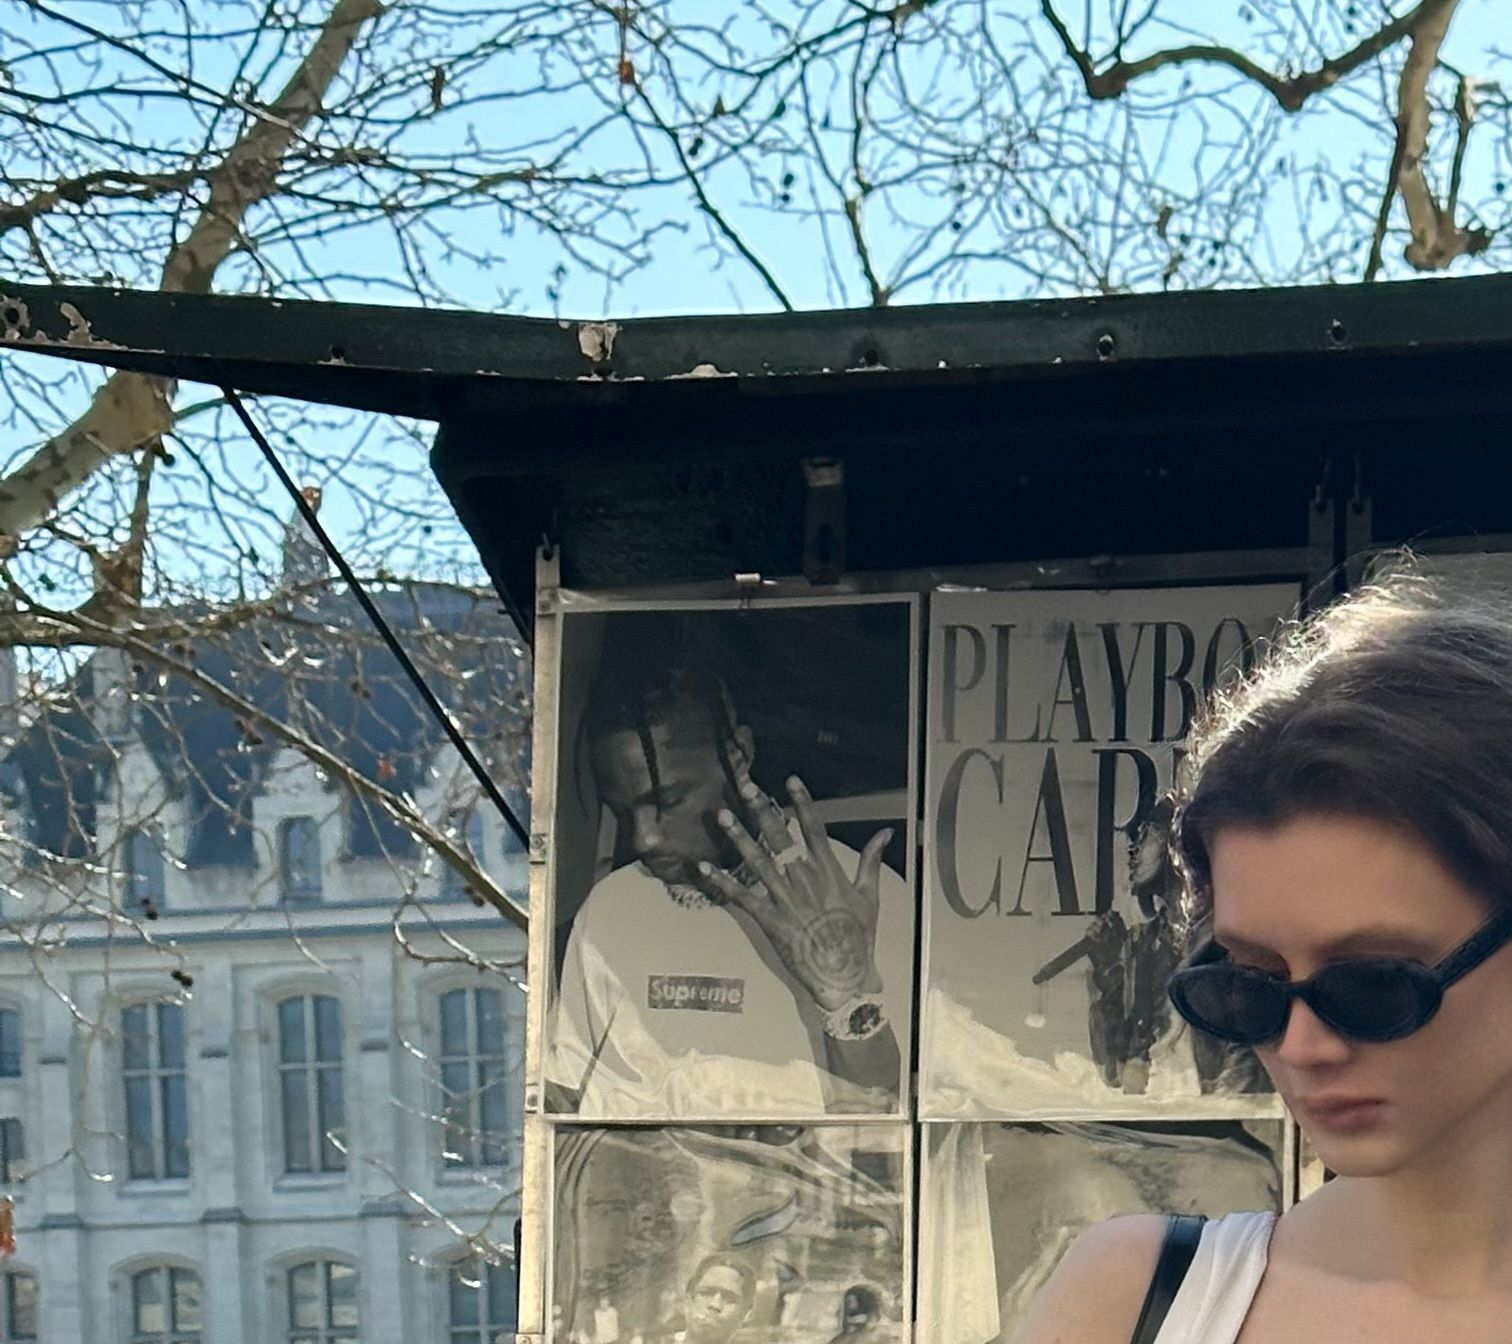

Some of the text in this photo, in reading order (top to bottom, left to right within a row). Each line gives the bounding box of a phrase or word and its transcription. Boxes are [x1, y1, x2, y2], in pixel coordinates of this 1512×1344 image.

[936, 617, 1256, 743] PLAYBO
[936, 746, 1190, 919] CAR
[650, 977, 742, 1007] Supreme
